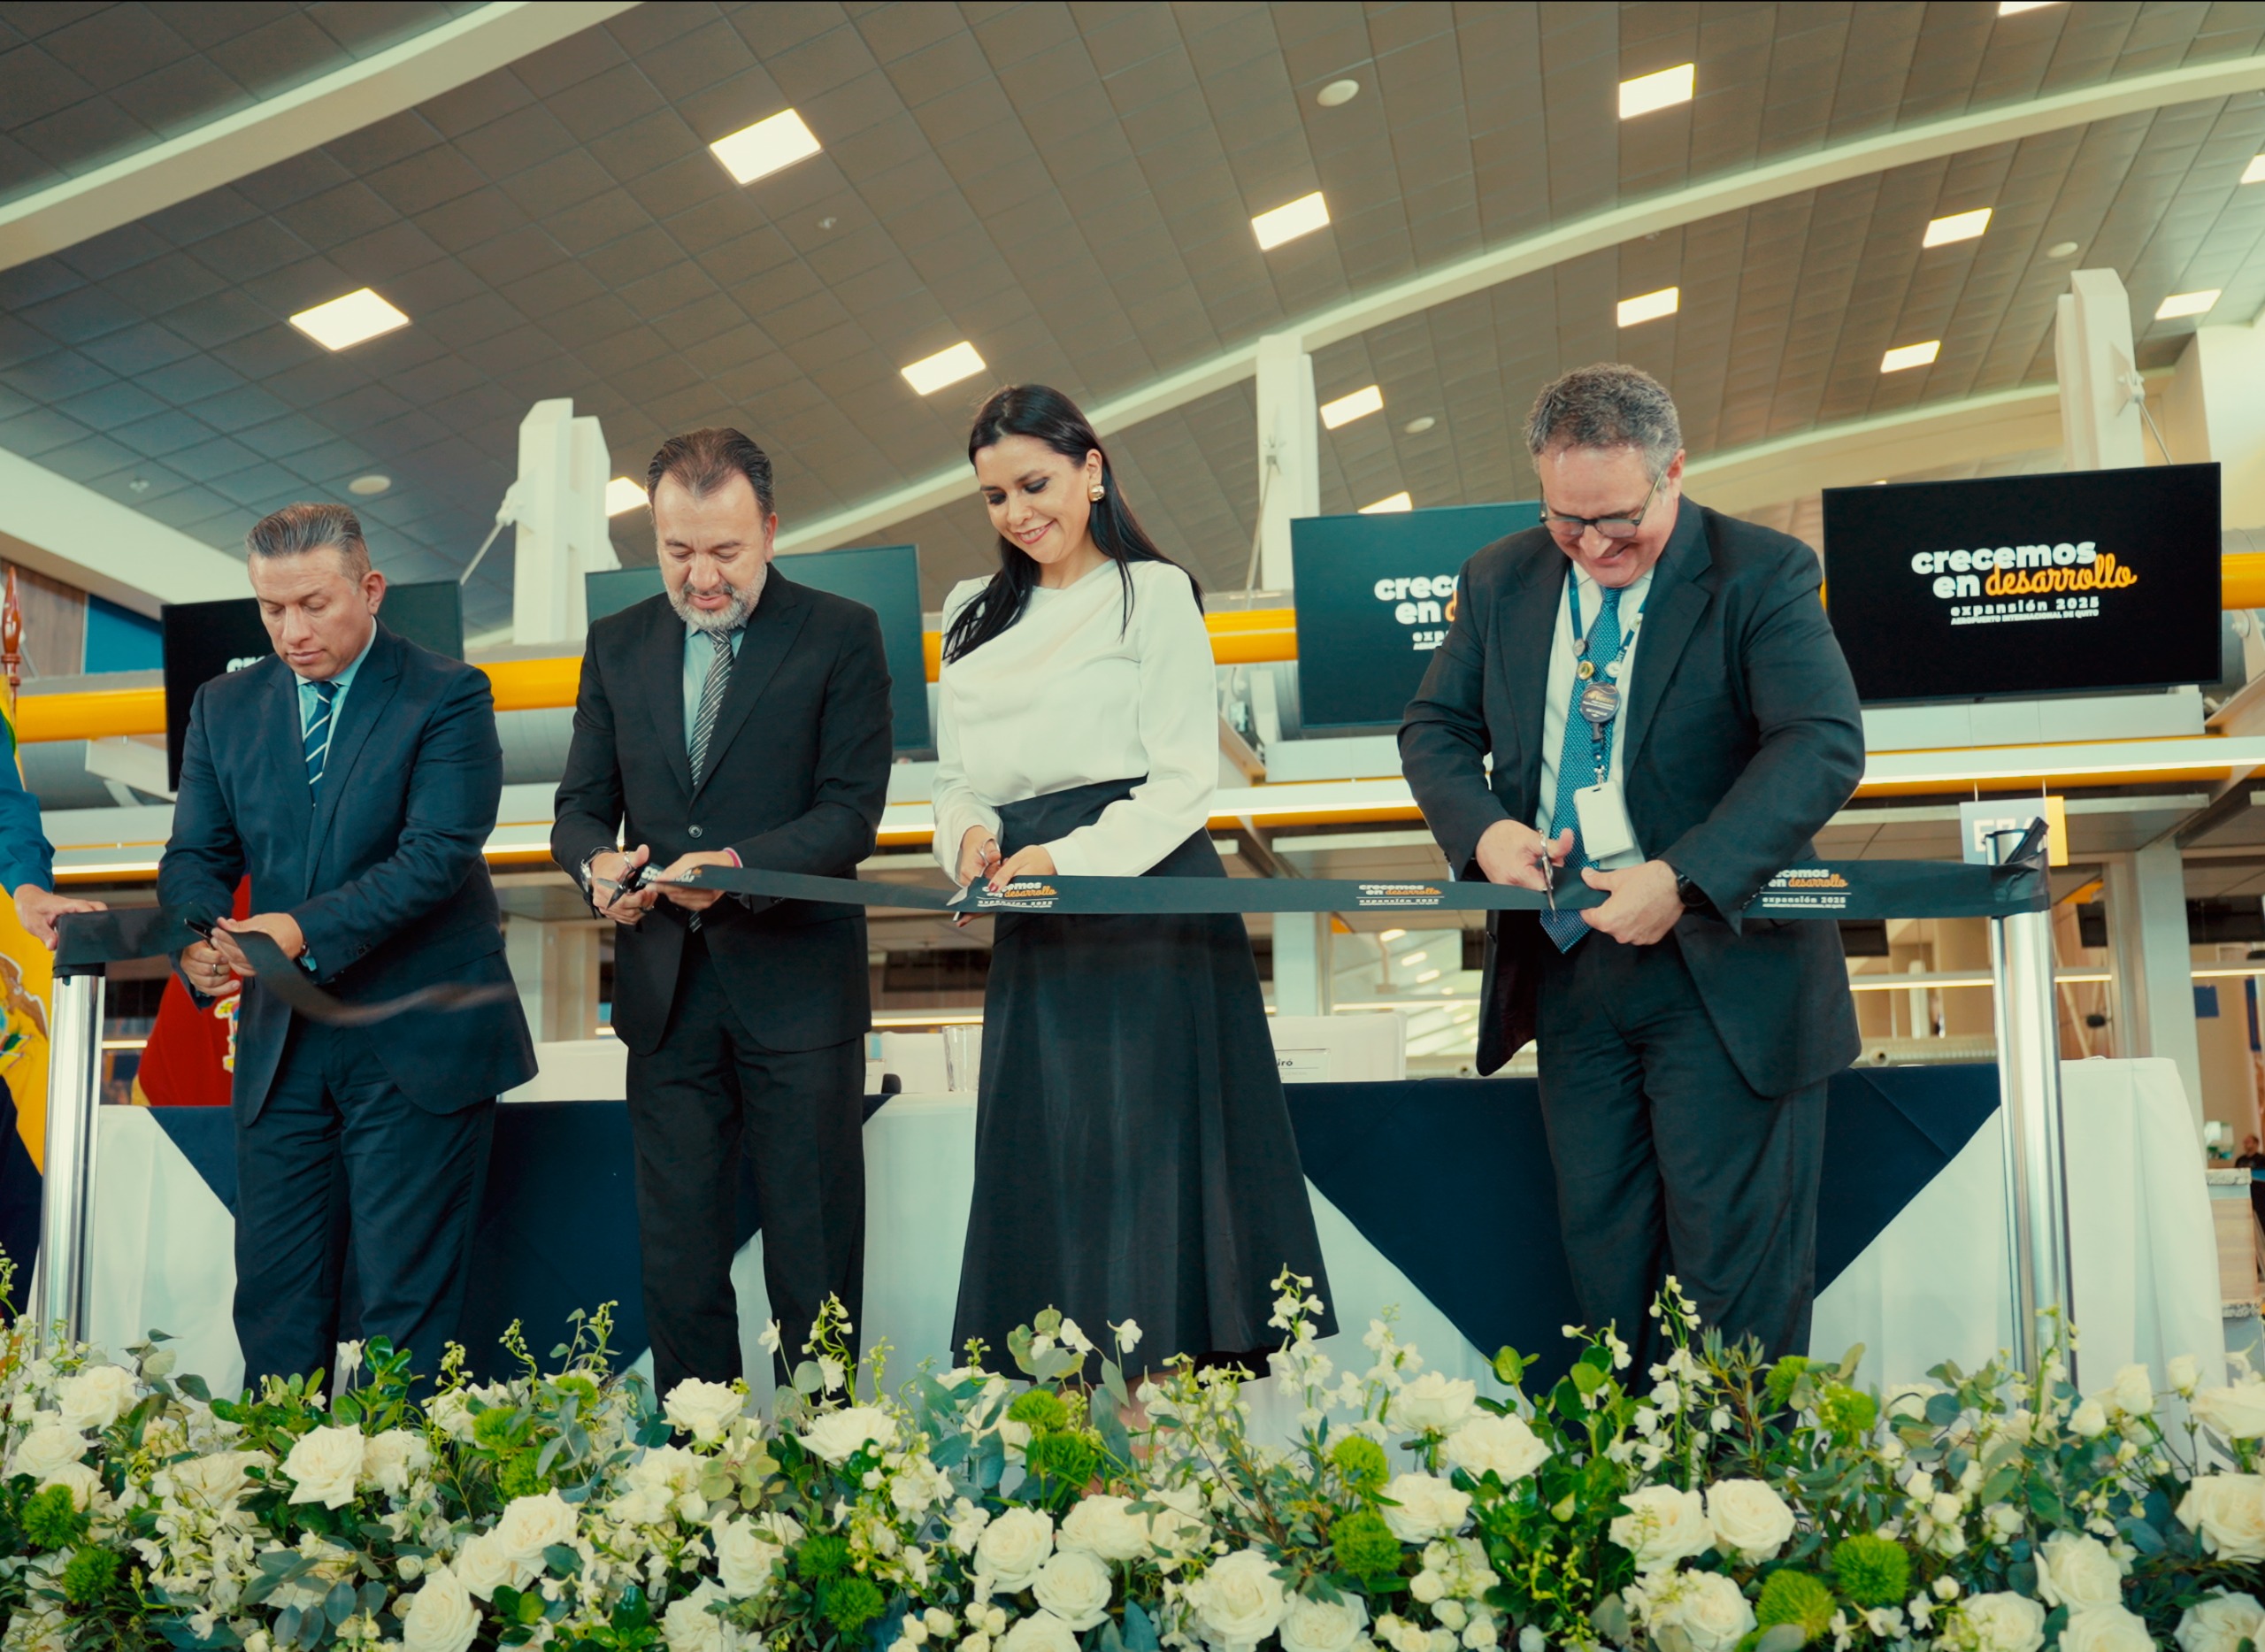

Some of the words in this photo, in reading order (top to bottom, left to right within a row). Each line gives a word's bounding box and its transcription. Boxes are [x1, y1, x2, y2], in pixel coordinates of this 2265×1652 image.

[1911, 542, 2097, 574] crecemos
[1932, 574, 1980, 598] en
[1985, 553, 2138, 595] desarrollo
[1395, 600, 1441, 625] en
[1950, 599, 2047, 617] expansión
[2055, 596, 2100, 611] 2025
[1951, 615, 2001, 626] AEROPUERTO
[2075, 609, 2100, 619] QUITO
